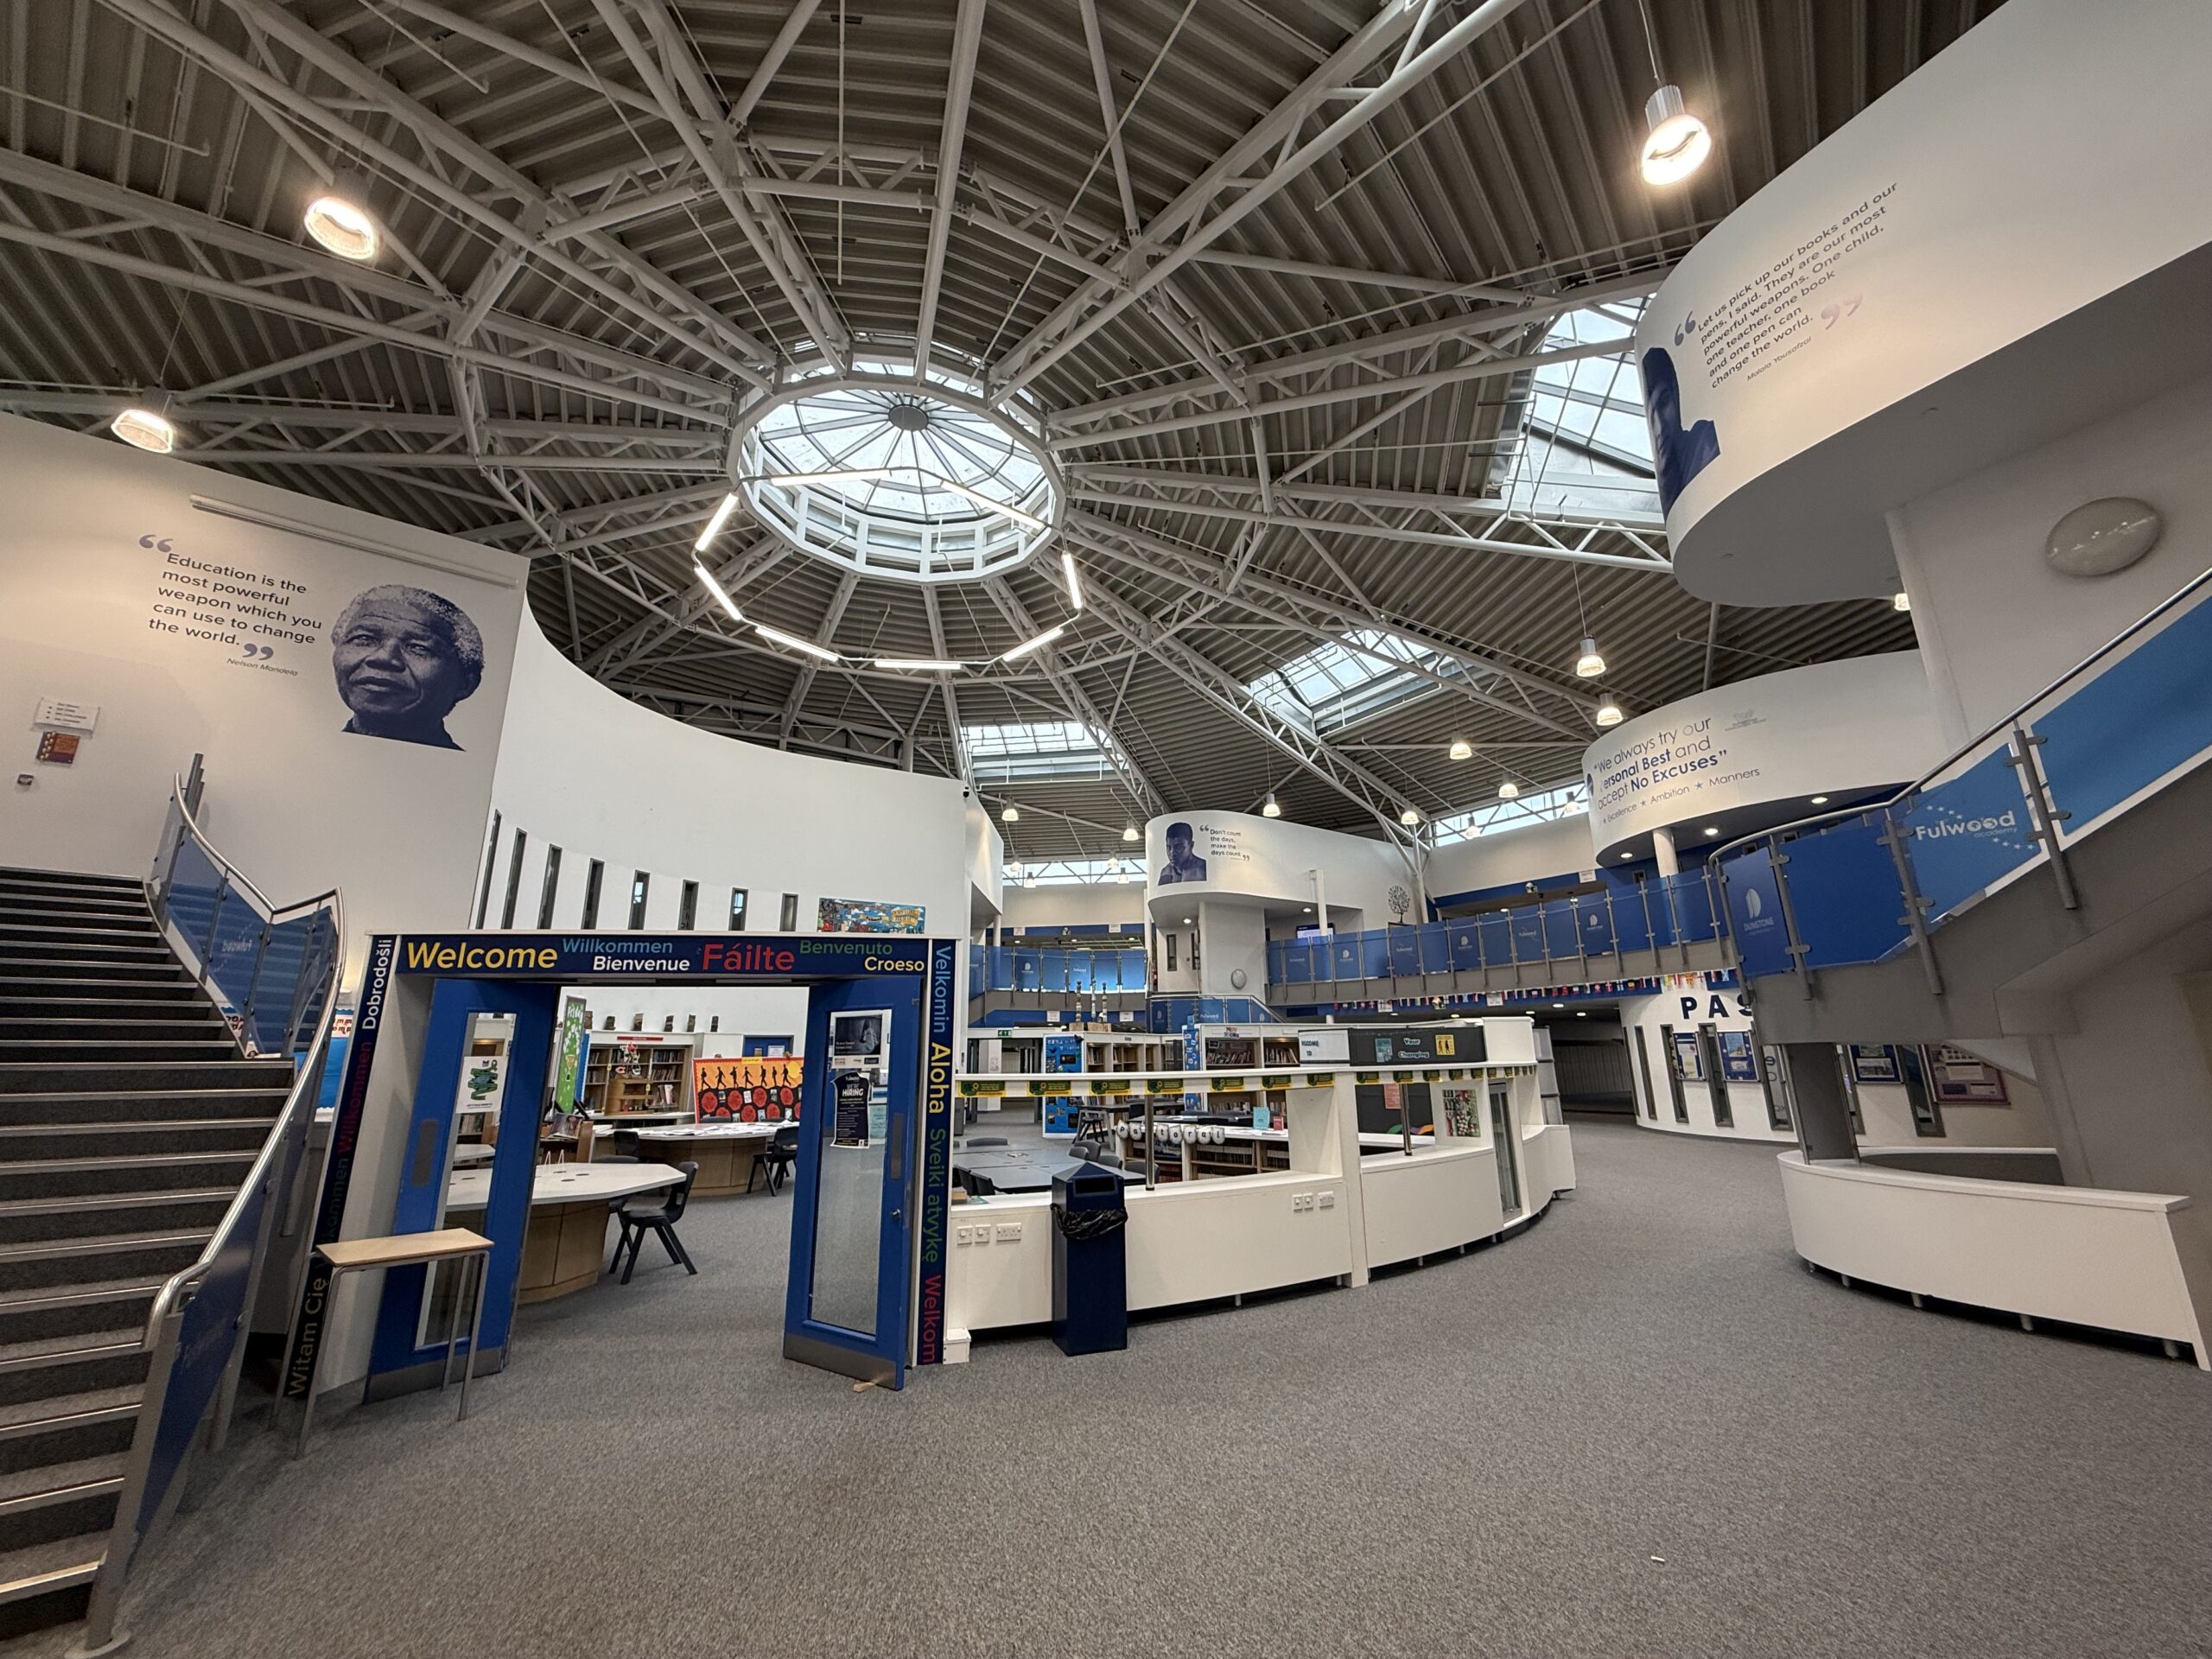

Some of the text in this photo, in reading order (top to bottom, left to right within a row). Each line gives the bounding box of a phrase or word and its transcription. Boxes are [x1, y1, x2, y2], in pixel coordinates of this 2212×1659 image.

[1698, 182, 1897, 332] Let us pick up our books and our
[1736, 293, 1761, 315] said.
[1764, 268, 1795, 292] They
[1798, 252, 1820, 270] are
[1823, 232, 1846, 252] our
[1850, 206, 1886, 235] most
[1703, 314, 1747, 356] powerful
[1750, 276, 1809, 317] weapons.
[1812, 252, 1841, 273] One
[1707, 347, 1725, 365] one
[1774, 296, 1798, 315] one
[1801, 270, 1835, 296] book
[1709, 307, 1802, 378] and one pen can
[1713, 315, 1814, 389] change the world.
[1747, 362, 1771, 382] Malala
[162, 570, 289, 606] most powerful
[167, 553, 307, 594] Education is the
[153, 604, 315, 644] can use to change
[158, 587, 322, 629] weapon which you
[149, 618, 240, 645] the world.
[226, 658, 298, 677] Nelson Mandela
[1614, 737, 1656, 765] always
[1658, 729, 1677, 745] try
[1682, 717, 1712, 736] our
[1600, 735, 1711, 792] ersonal Best and
[1599, 784, 1629, 810] accept
[1630, 777, 1649, 792] No
[1650, 786, 1690, 804] Ambition
[1709, 767, 1760, 787] Manners
[1916, 810, 2016, 841] Fulwood
[408, 942, 558, 969] Welcome
[562, 938, 673, 954] Willkommen
[593, 956, 690, 971] Bienvenue
[702, 943, 795, 970] Fáilte
[799, 940, 893, 955] Benvenuto
[864, 957, 925, 972] Croeso
[362, 939, 391, 1029] Dobrodošli
[933, 945, 951, 1033] Velkomin
[929, 1042, 951, 1114] Aloha
[922, 1128, 945, 1263] Sveiki atvykę
[923, 1274, 941, 1363] Welkom
[288, 1323, 318, 1395] Witam
